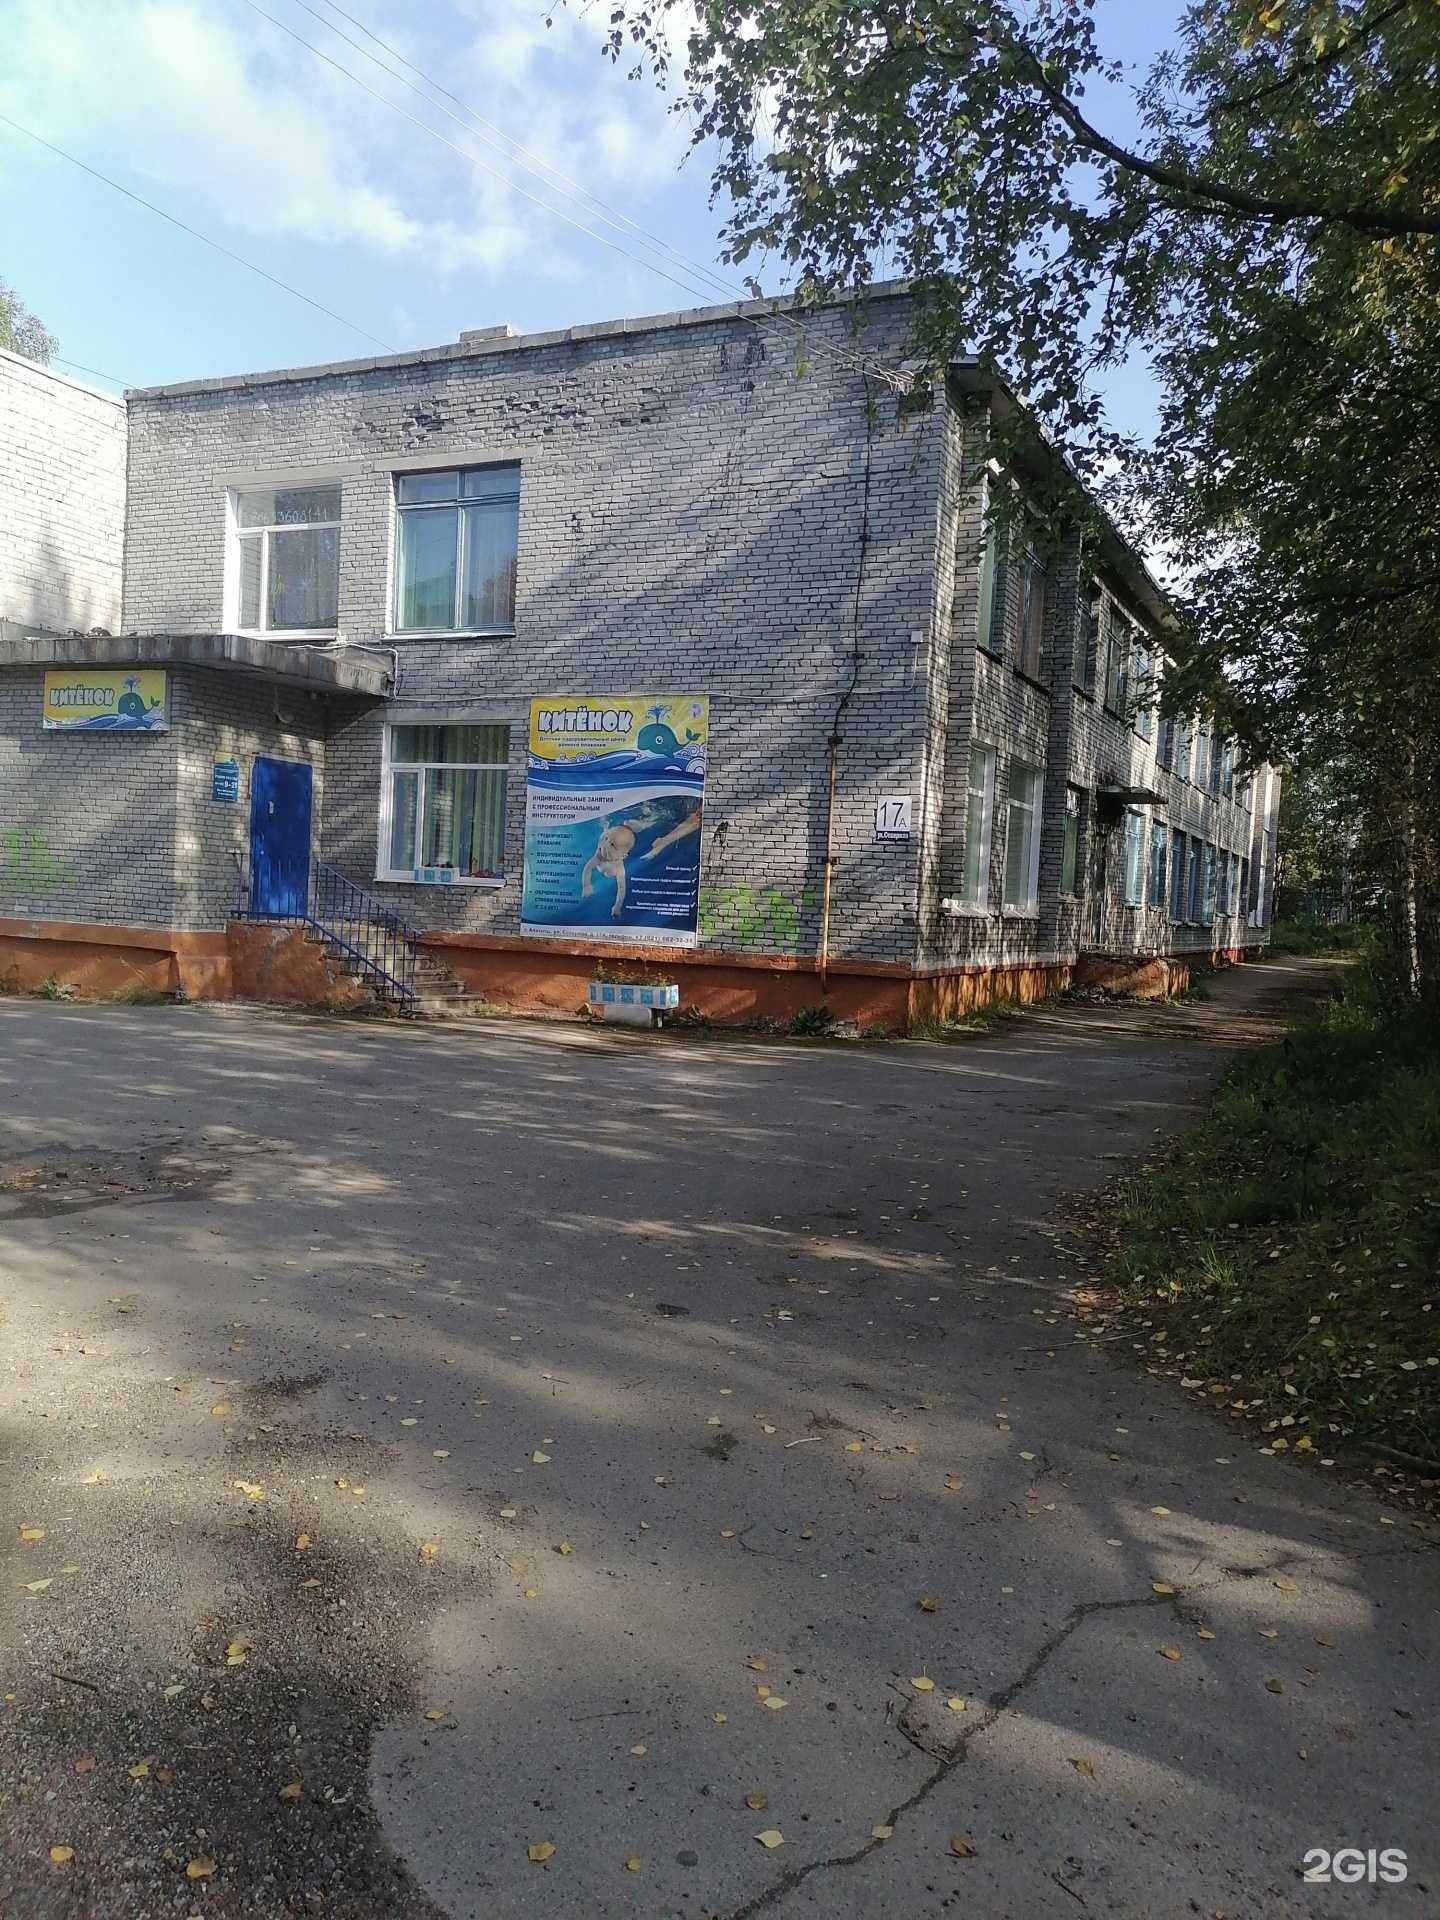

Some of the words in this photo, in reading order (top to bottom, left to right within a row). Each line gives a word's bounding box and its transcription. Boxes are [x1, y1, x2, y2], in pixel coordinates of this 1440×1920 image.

[50, 684, 115, 707] КИТЁНОК
[538, 705, 633, 733] КИТЁНОК
[532, 795, 586, 803] ИНДИВИДУАЛЬНЫЕ
